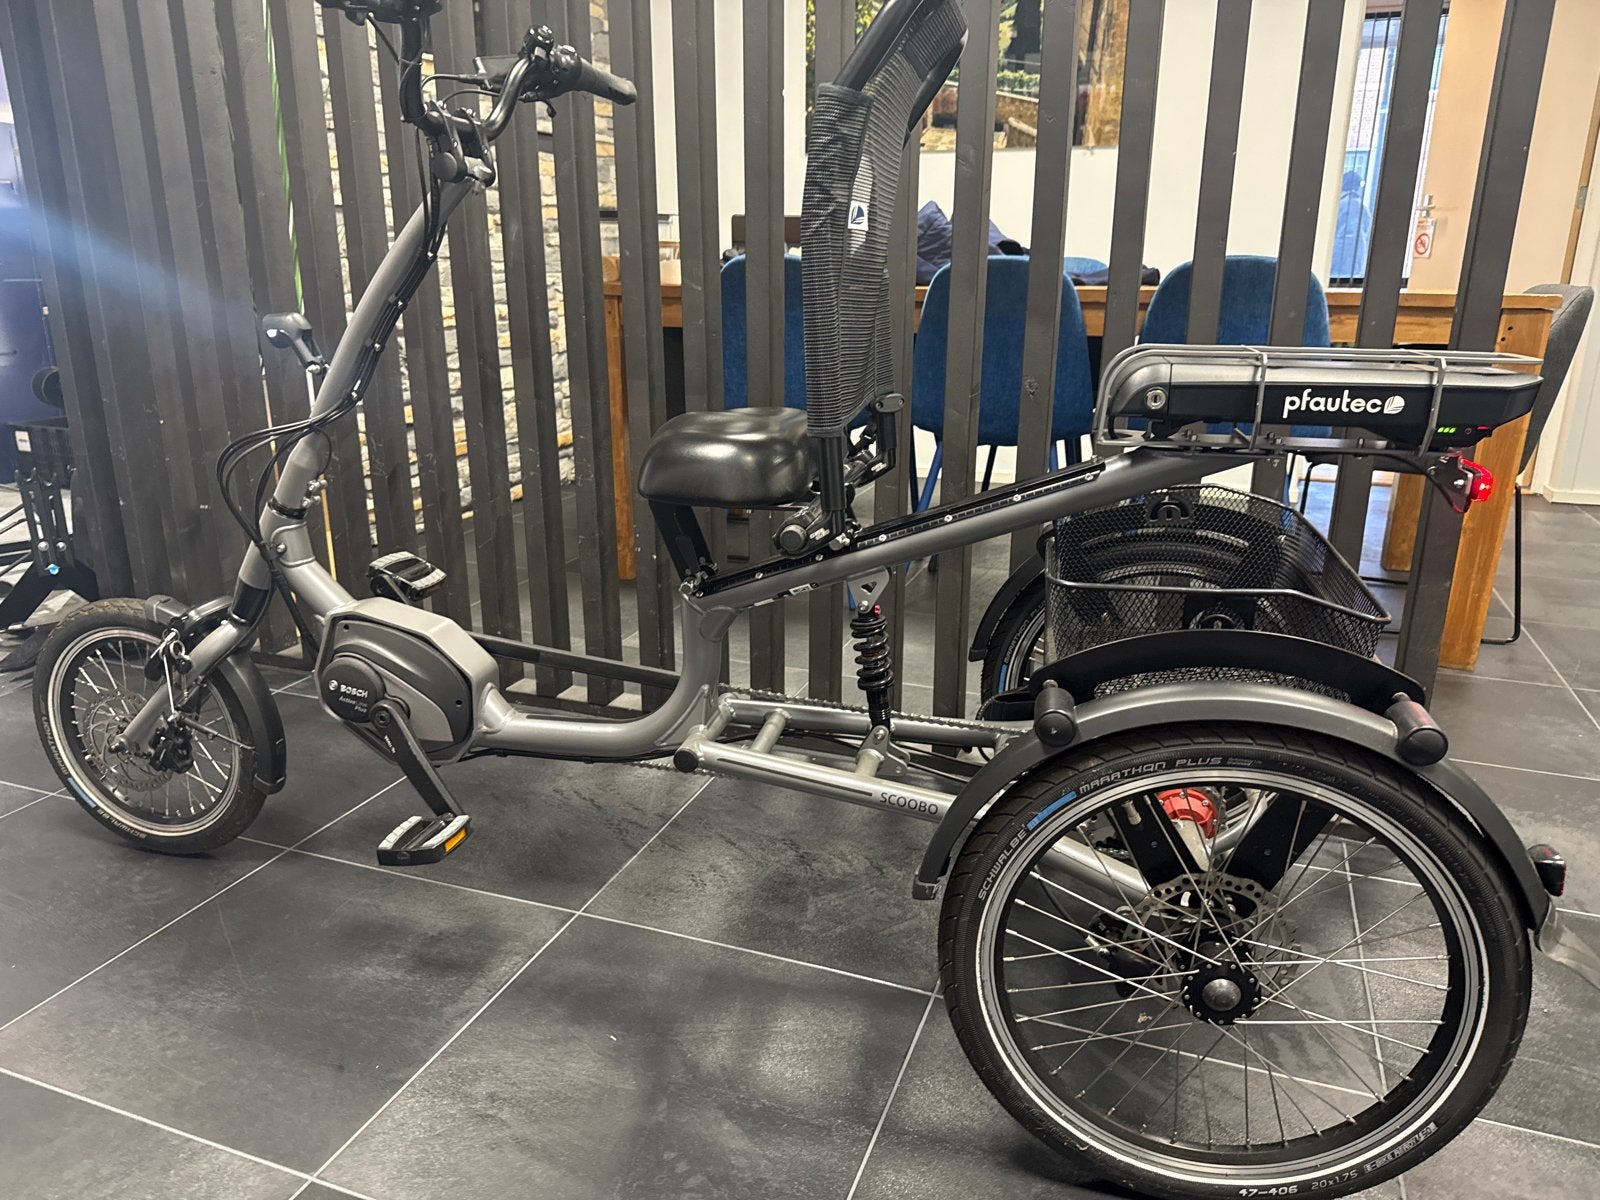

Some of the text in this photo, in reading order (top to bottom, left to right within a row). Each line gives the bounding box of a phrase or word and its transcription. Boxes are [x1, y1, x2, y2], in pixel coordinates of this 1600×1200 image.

[1282, 388, 1382, 419] pfautec
[340, 684, 369, 699] BOSCH
[42, 715, 69, 775] MARATHON
[880, 792, 938, 815] SCOOBO
[978, 757, 1223, 901] SCHWALBE MARATHON PLUS
[1238, 1185, 1299, 1197] 47-406
[1311, 1171, 1358, 1190] 20x1.75
